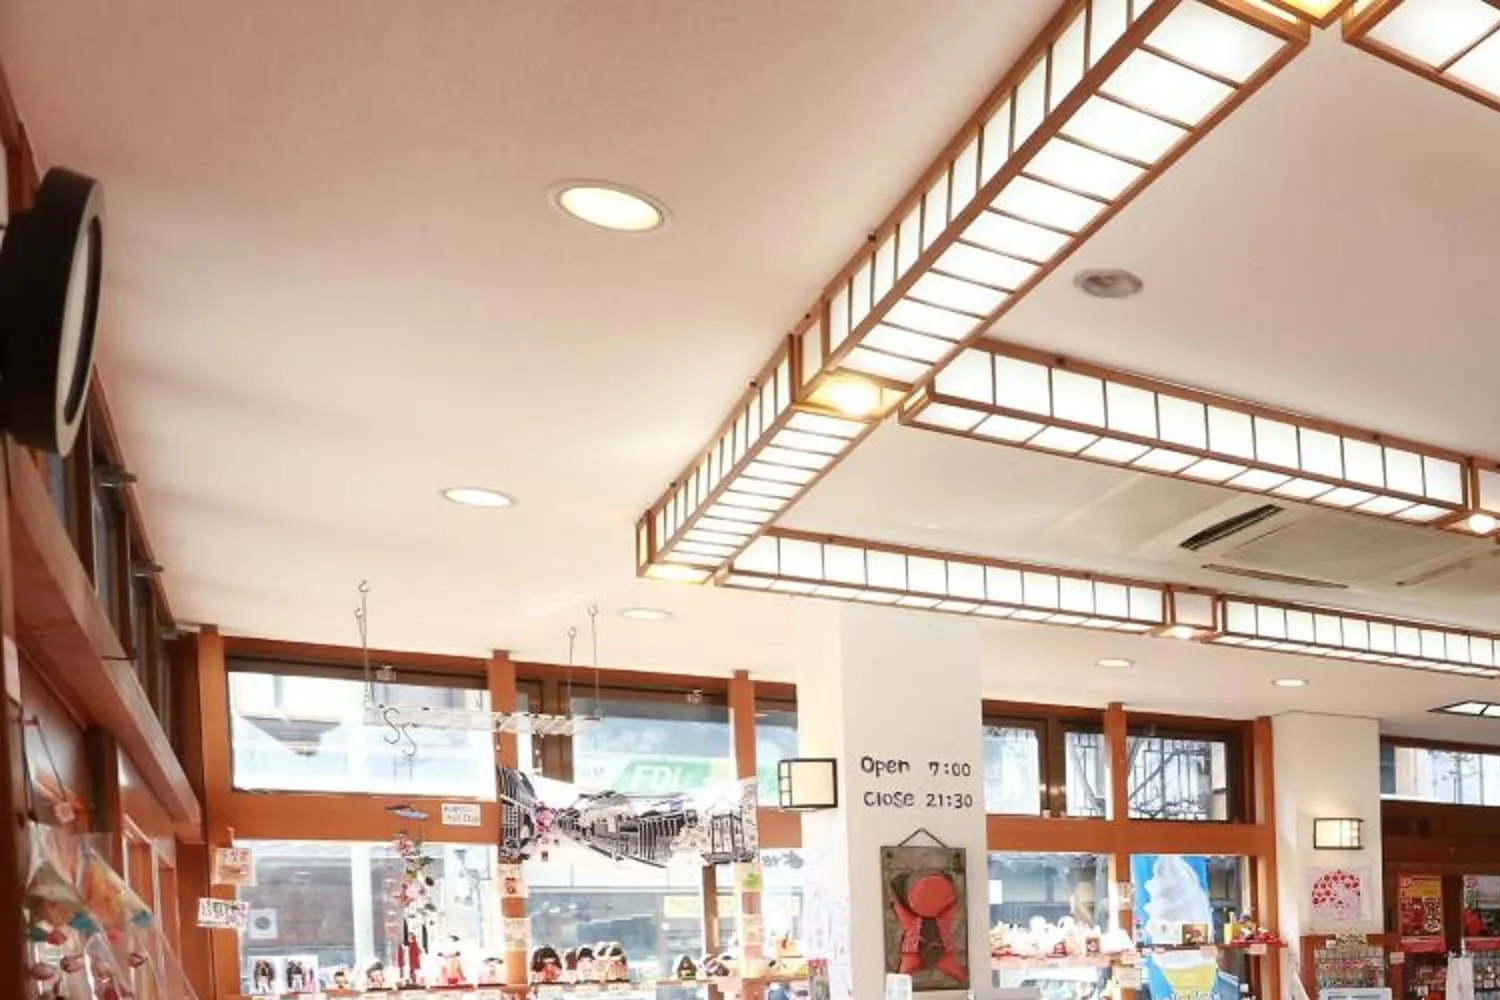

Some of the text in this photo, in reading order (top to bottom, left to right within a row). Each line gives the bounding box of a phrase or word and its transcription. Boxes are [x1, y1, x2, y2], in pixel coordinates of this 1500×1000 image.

[861, 756, 971, 778] Open 7:00
[863, 791, 973, 809] Close 21:30
